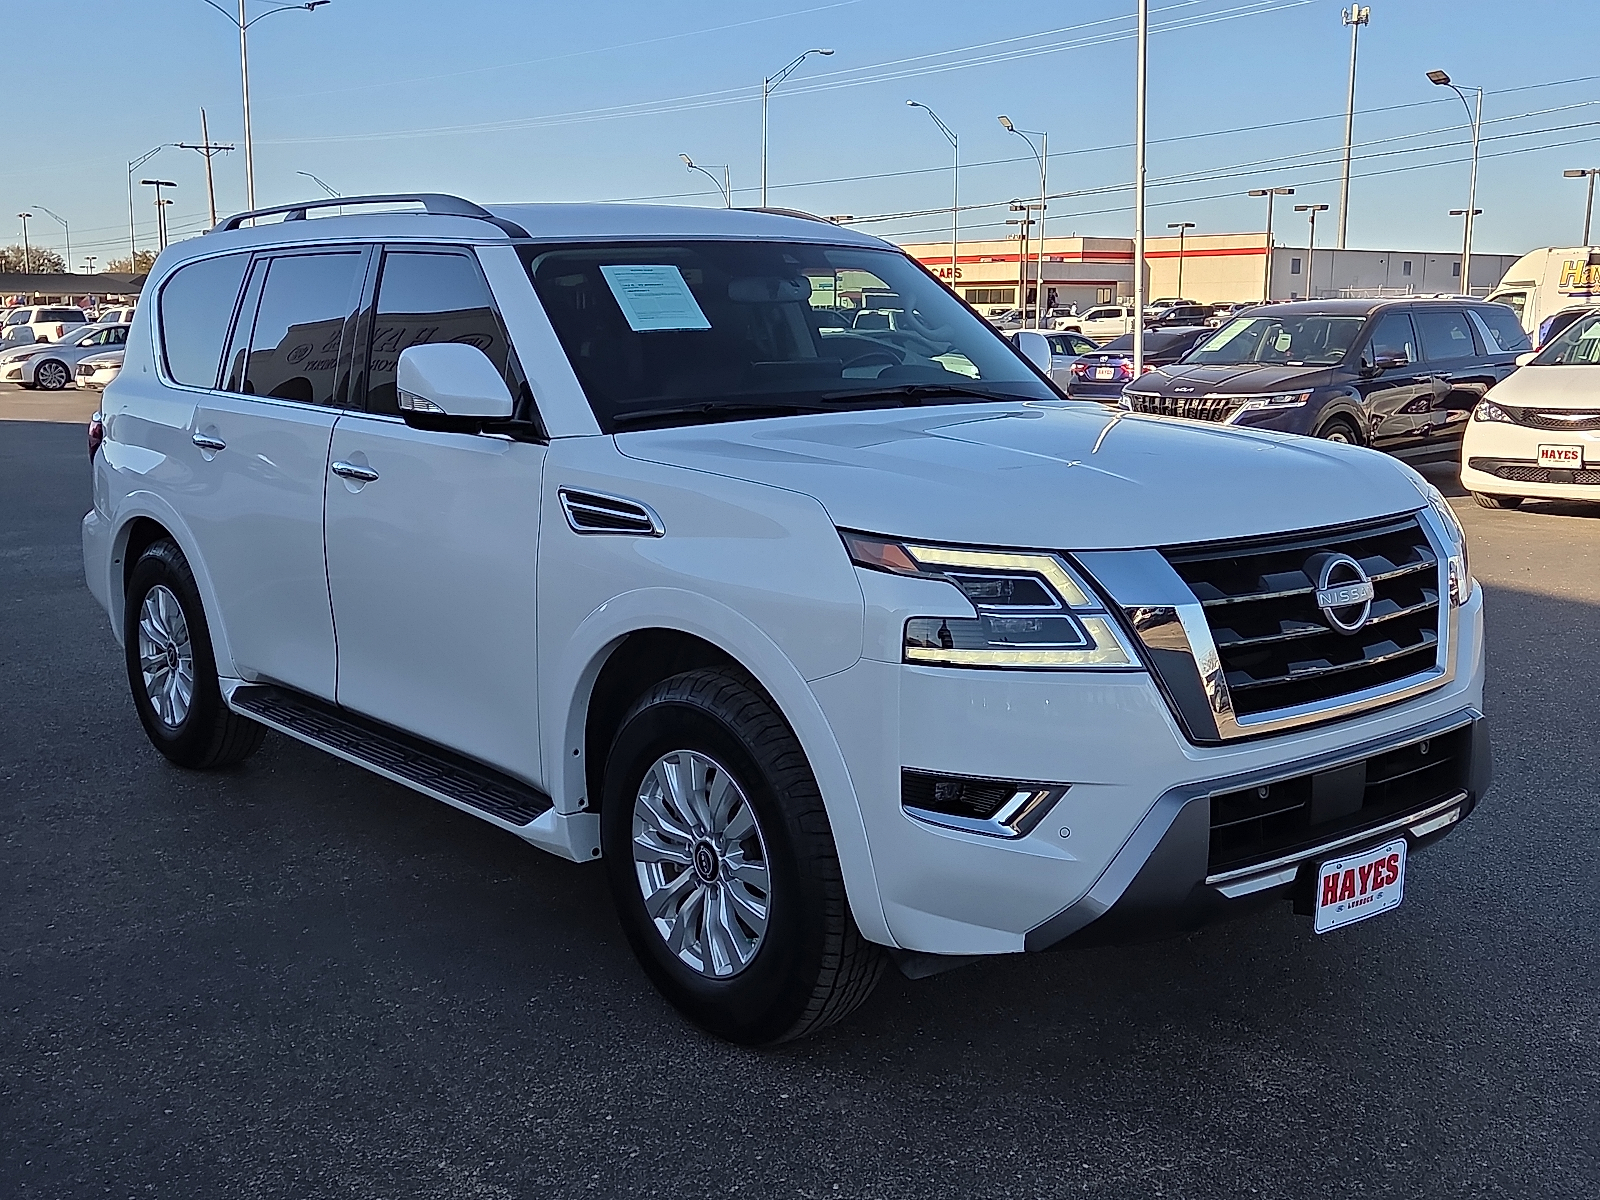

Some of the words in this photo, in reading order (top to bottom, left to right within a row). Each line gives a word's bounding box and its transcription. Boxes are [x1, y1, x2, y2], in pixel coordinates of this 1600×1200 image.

[1541, 449, 1579, 460] HAYES
[1319, 584, 1373, 605] NISSAN
[1321, 853, 1400, 908] HAYES
